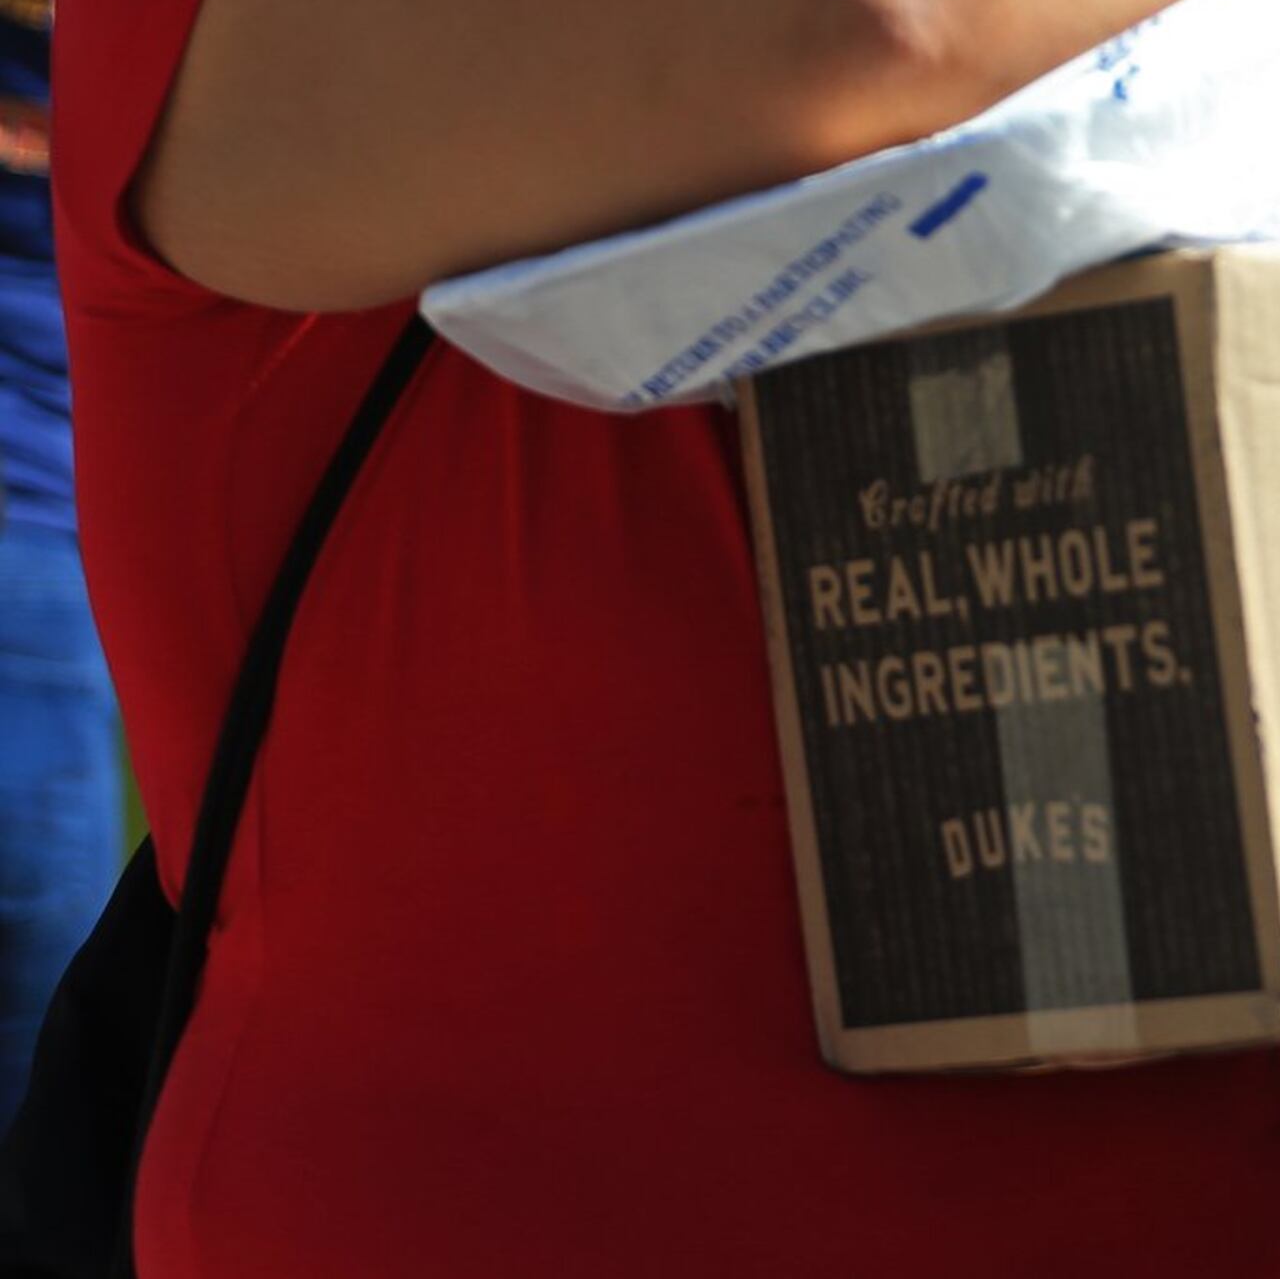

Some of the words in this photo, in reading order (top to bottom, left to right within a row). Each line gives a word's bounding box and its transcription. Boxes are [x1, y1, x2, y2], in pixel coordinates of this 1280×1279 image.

[858, 477, 1002, 533] Crafted
[1014, 455, 1094, 510] with
[810, 556, 968, 631] REAL,
[967, 520, 1163, 610] WHOLE
[820, 623, 1191, 726] INGREDIENTS.
